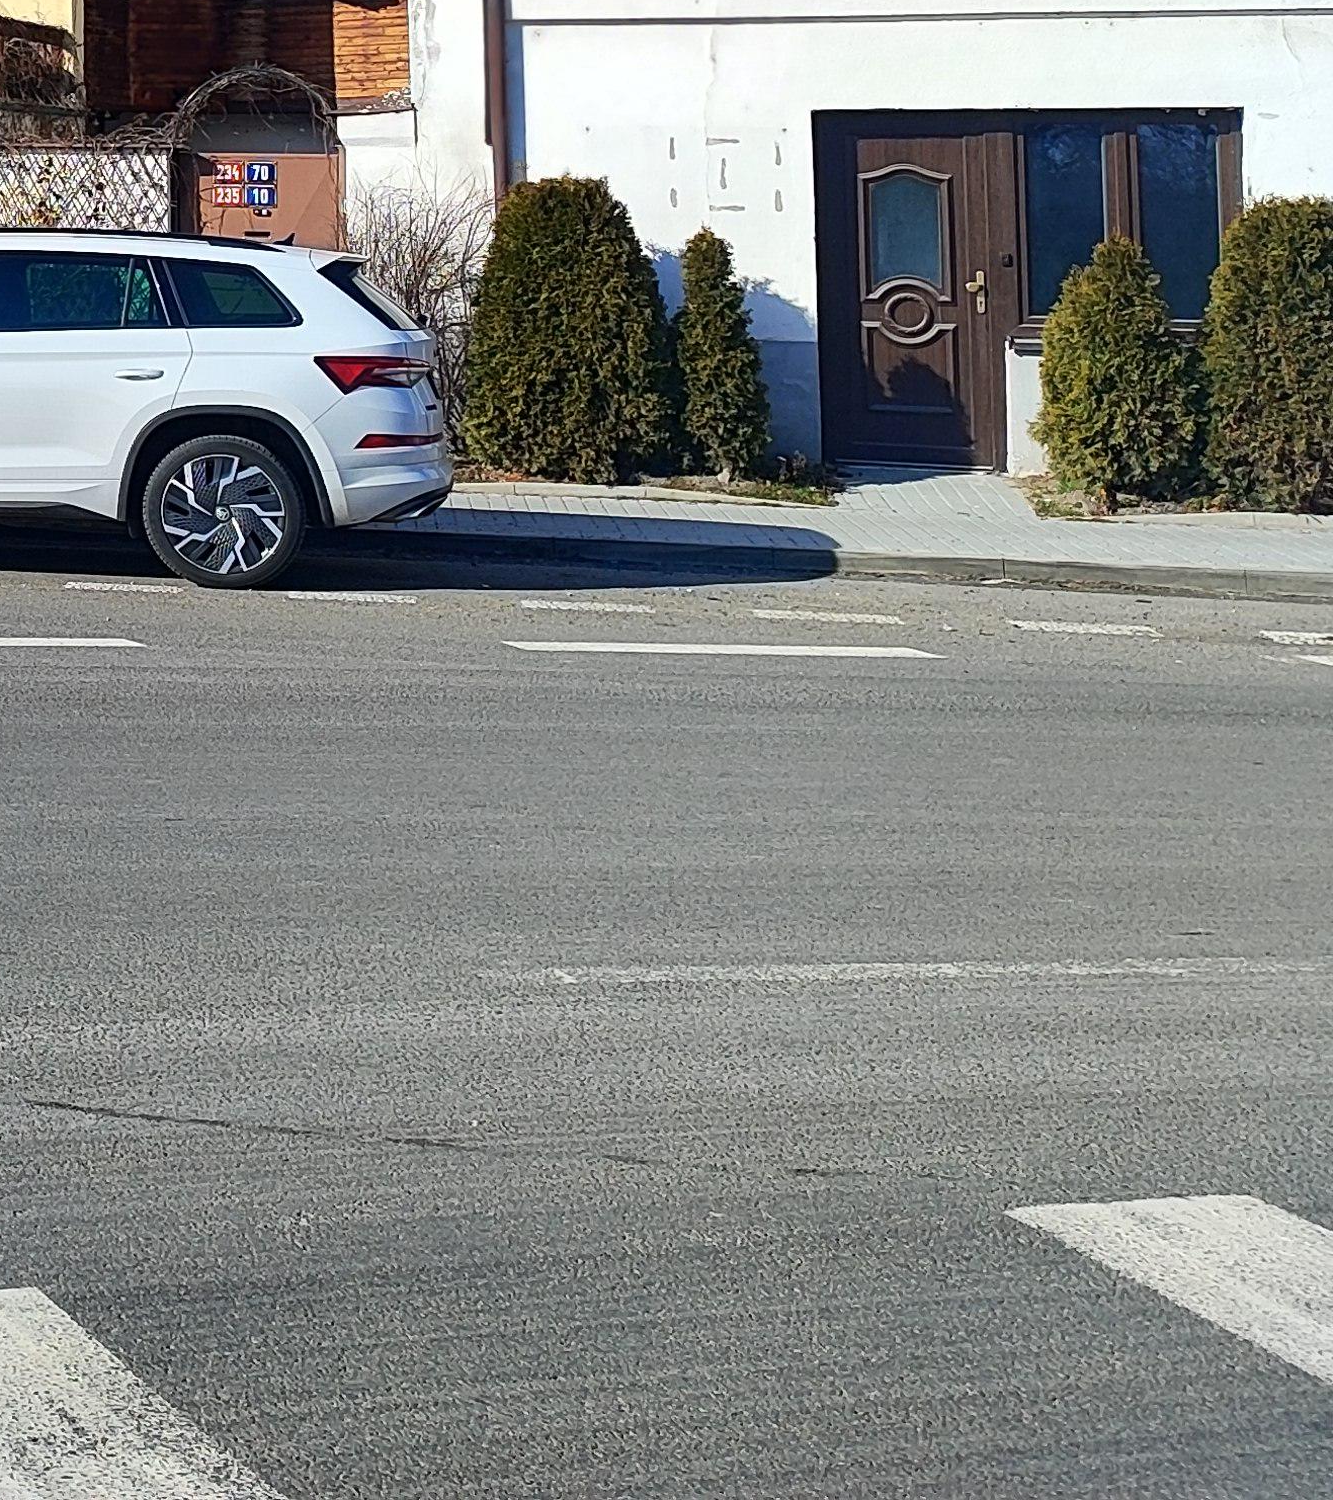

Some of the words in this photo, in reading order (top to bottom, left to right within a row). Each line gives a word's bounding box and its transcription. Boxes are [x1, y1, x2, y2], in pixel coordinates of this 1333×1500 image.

[216, 164, 240, 180] 234
[251, 164, 269, 180] 70
[216, 187, 240, 204] 235
[253, 187, 269, 204] 10
